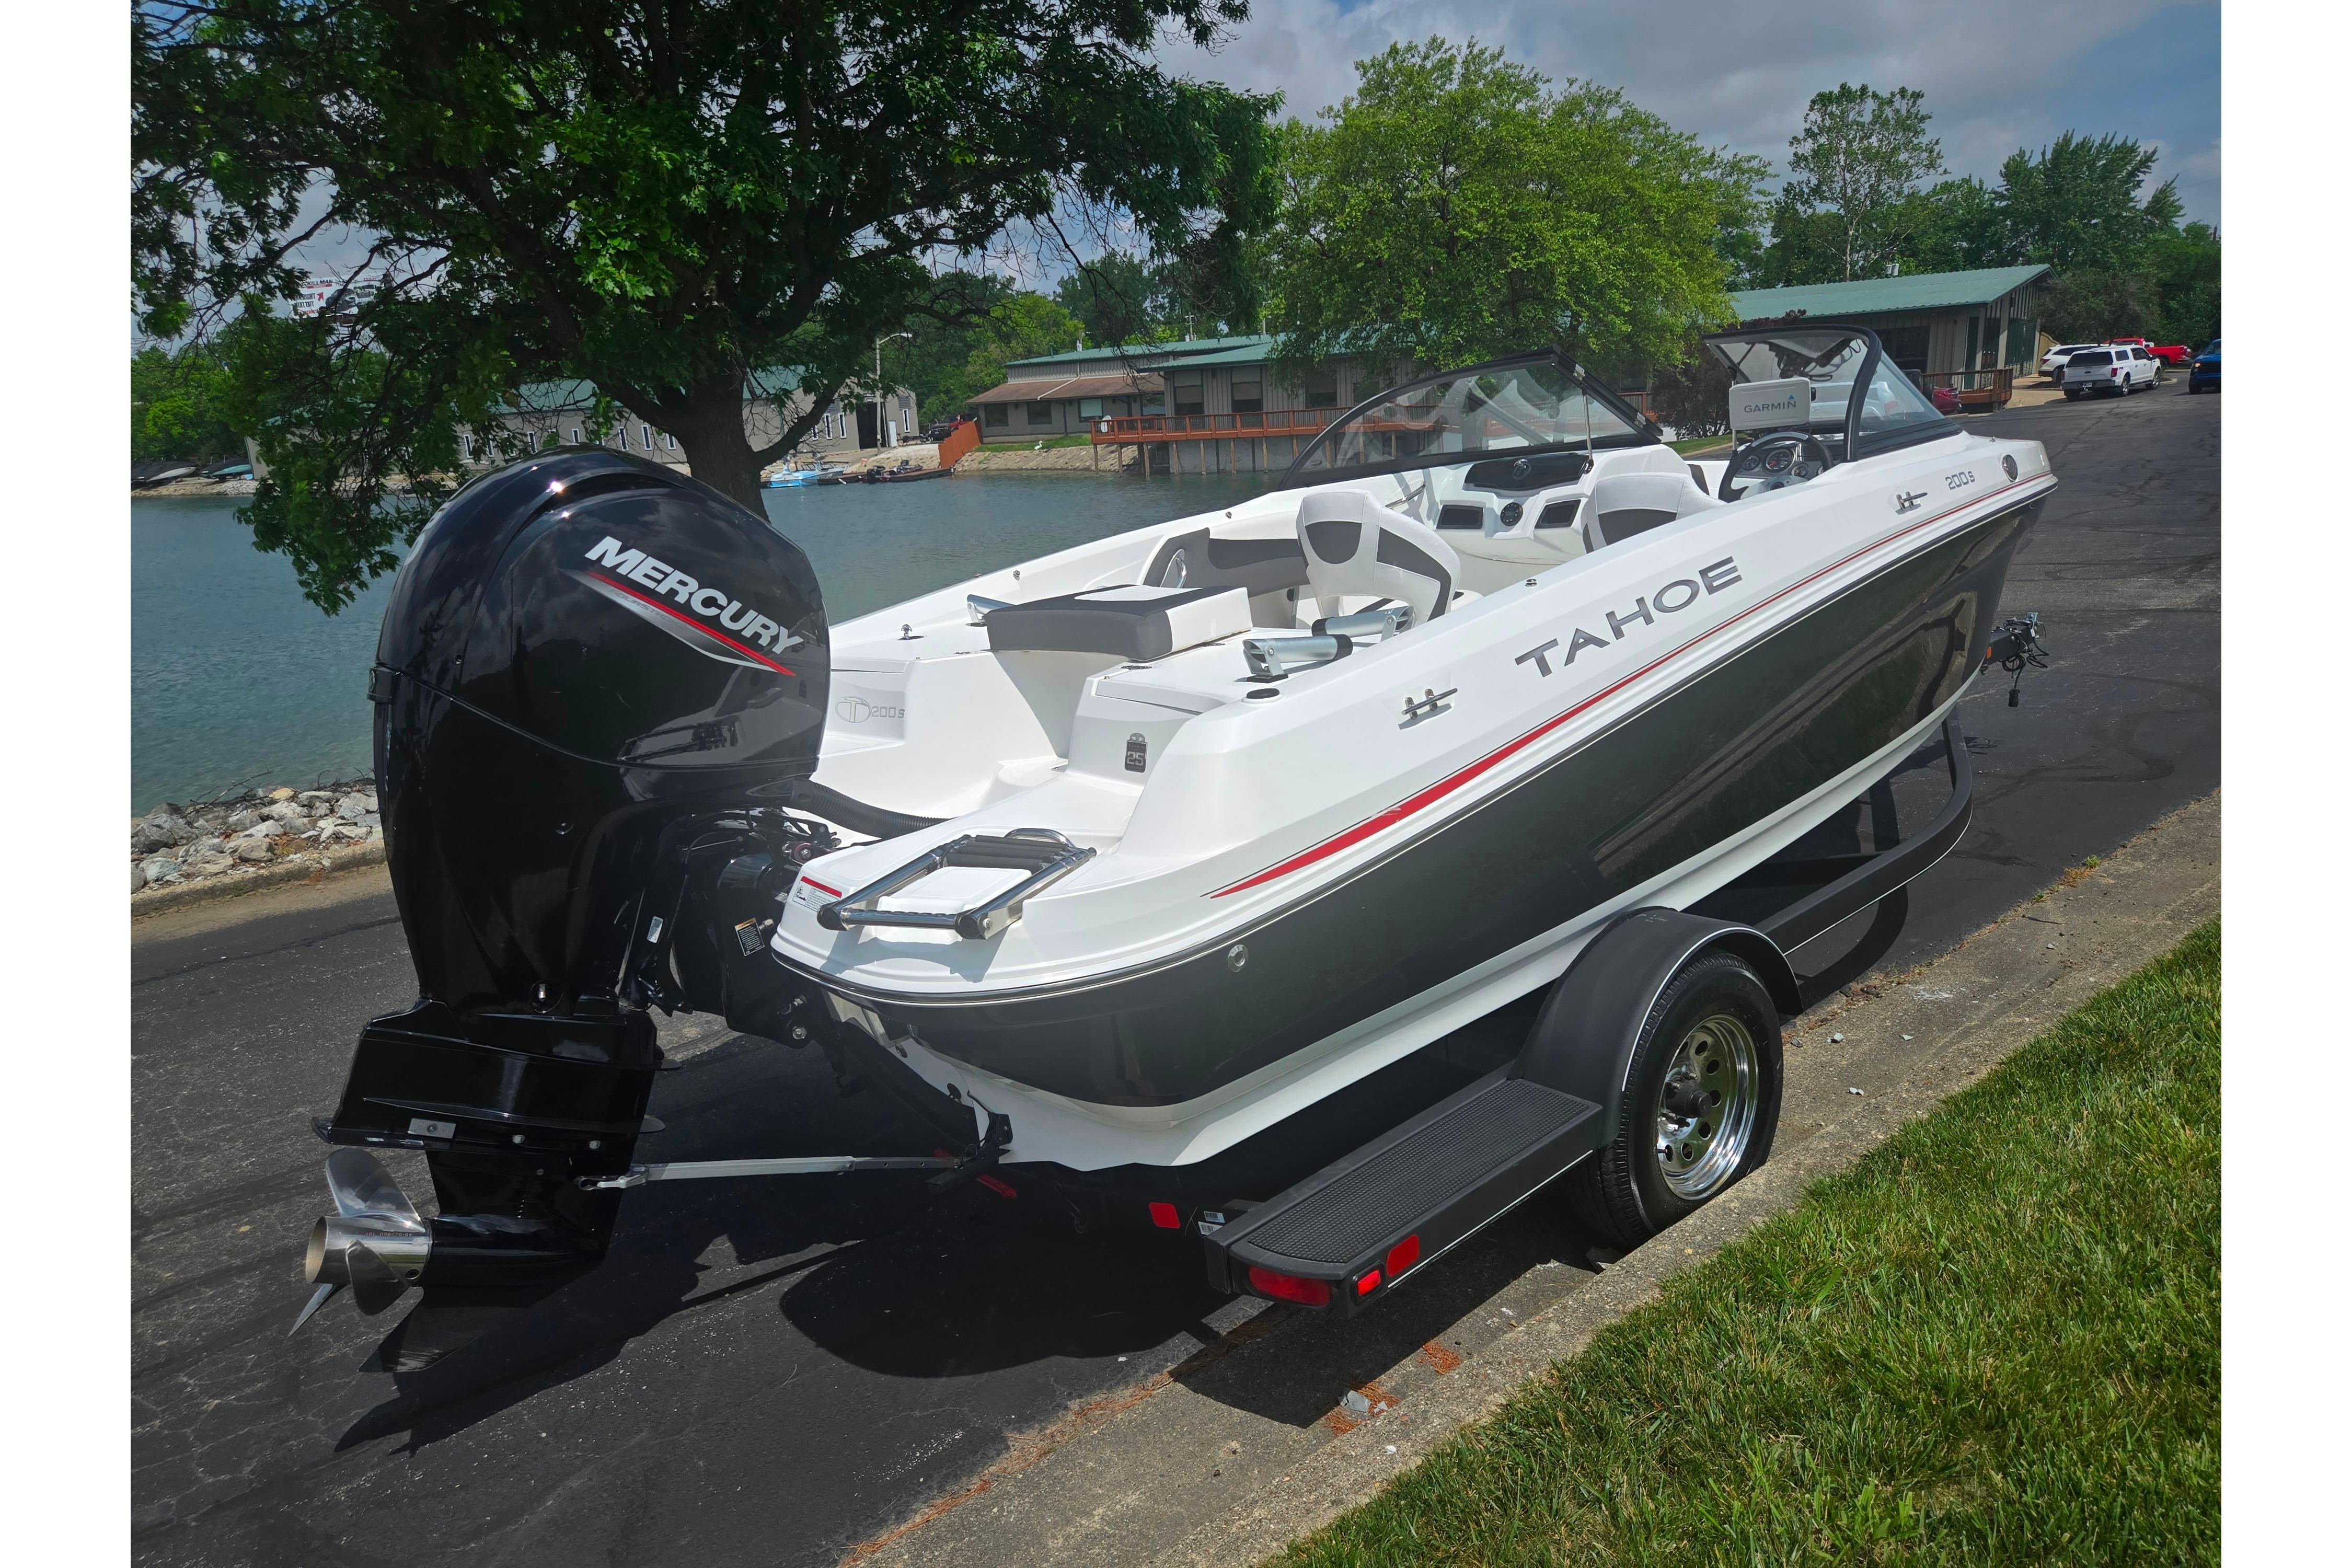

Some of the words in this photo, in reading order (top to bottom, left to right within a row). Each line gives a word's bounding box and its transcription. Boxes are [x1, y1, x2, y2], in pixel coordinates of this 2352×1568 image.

[1744, 400, 1796, 413] GARMIN
[585, 536, 804, 654] MERCURY
[1514, 556, 1743, 678] TAHOE
[1127, 751, 1144, 766] 25
